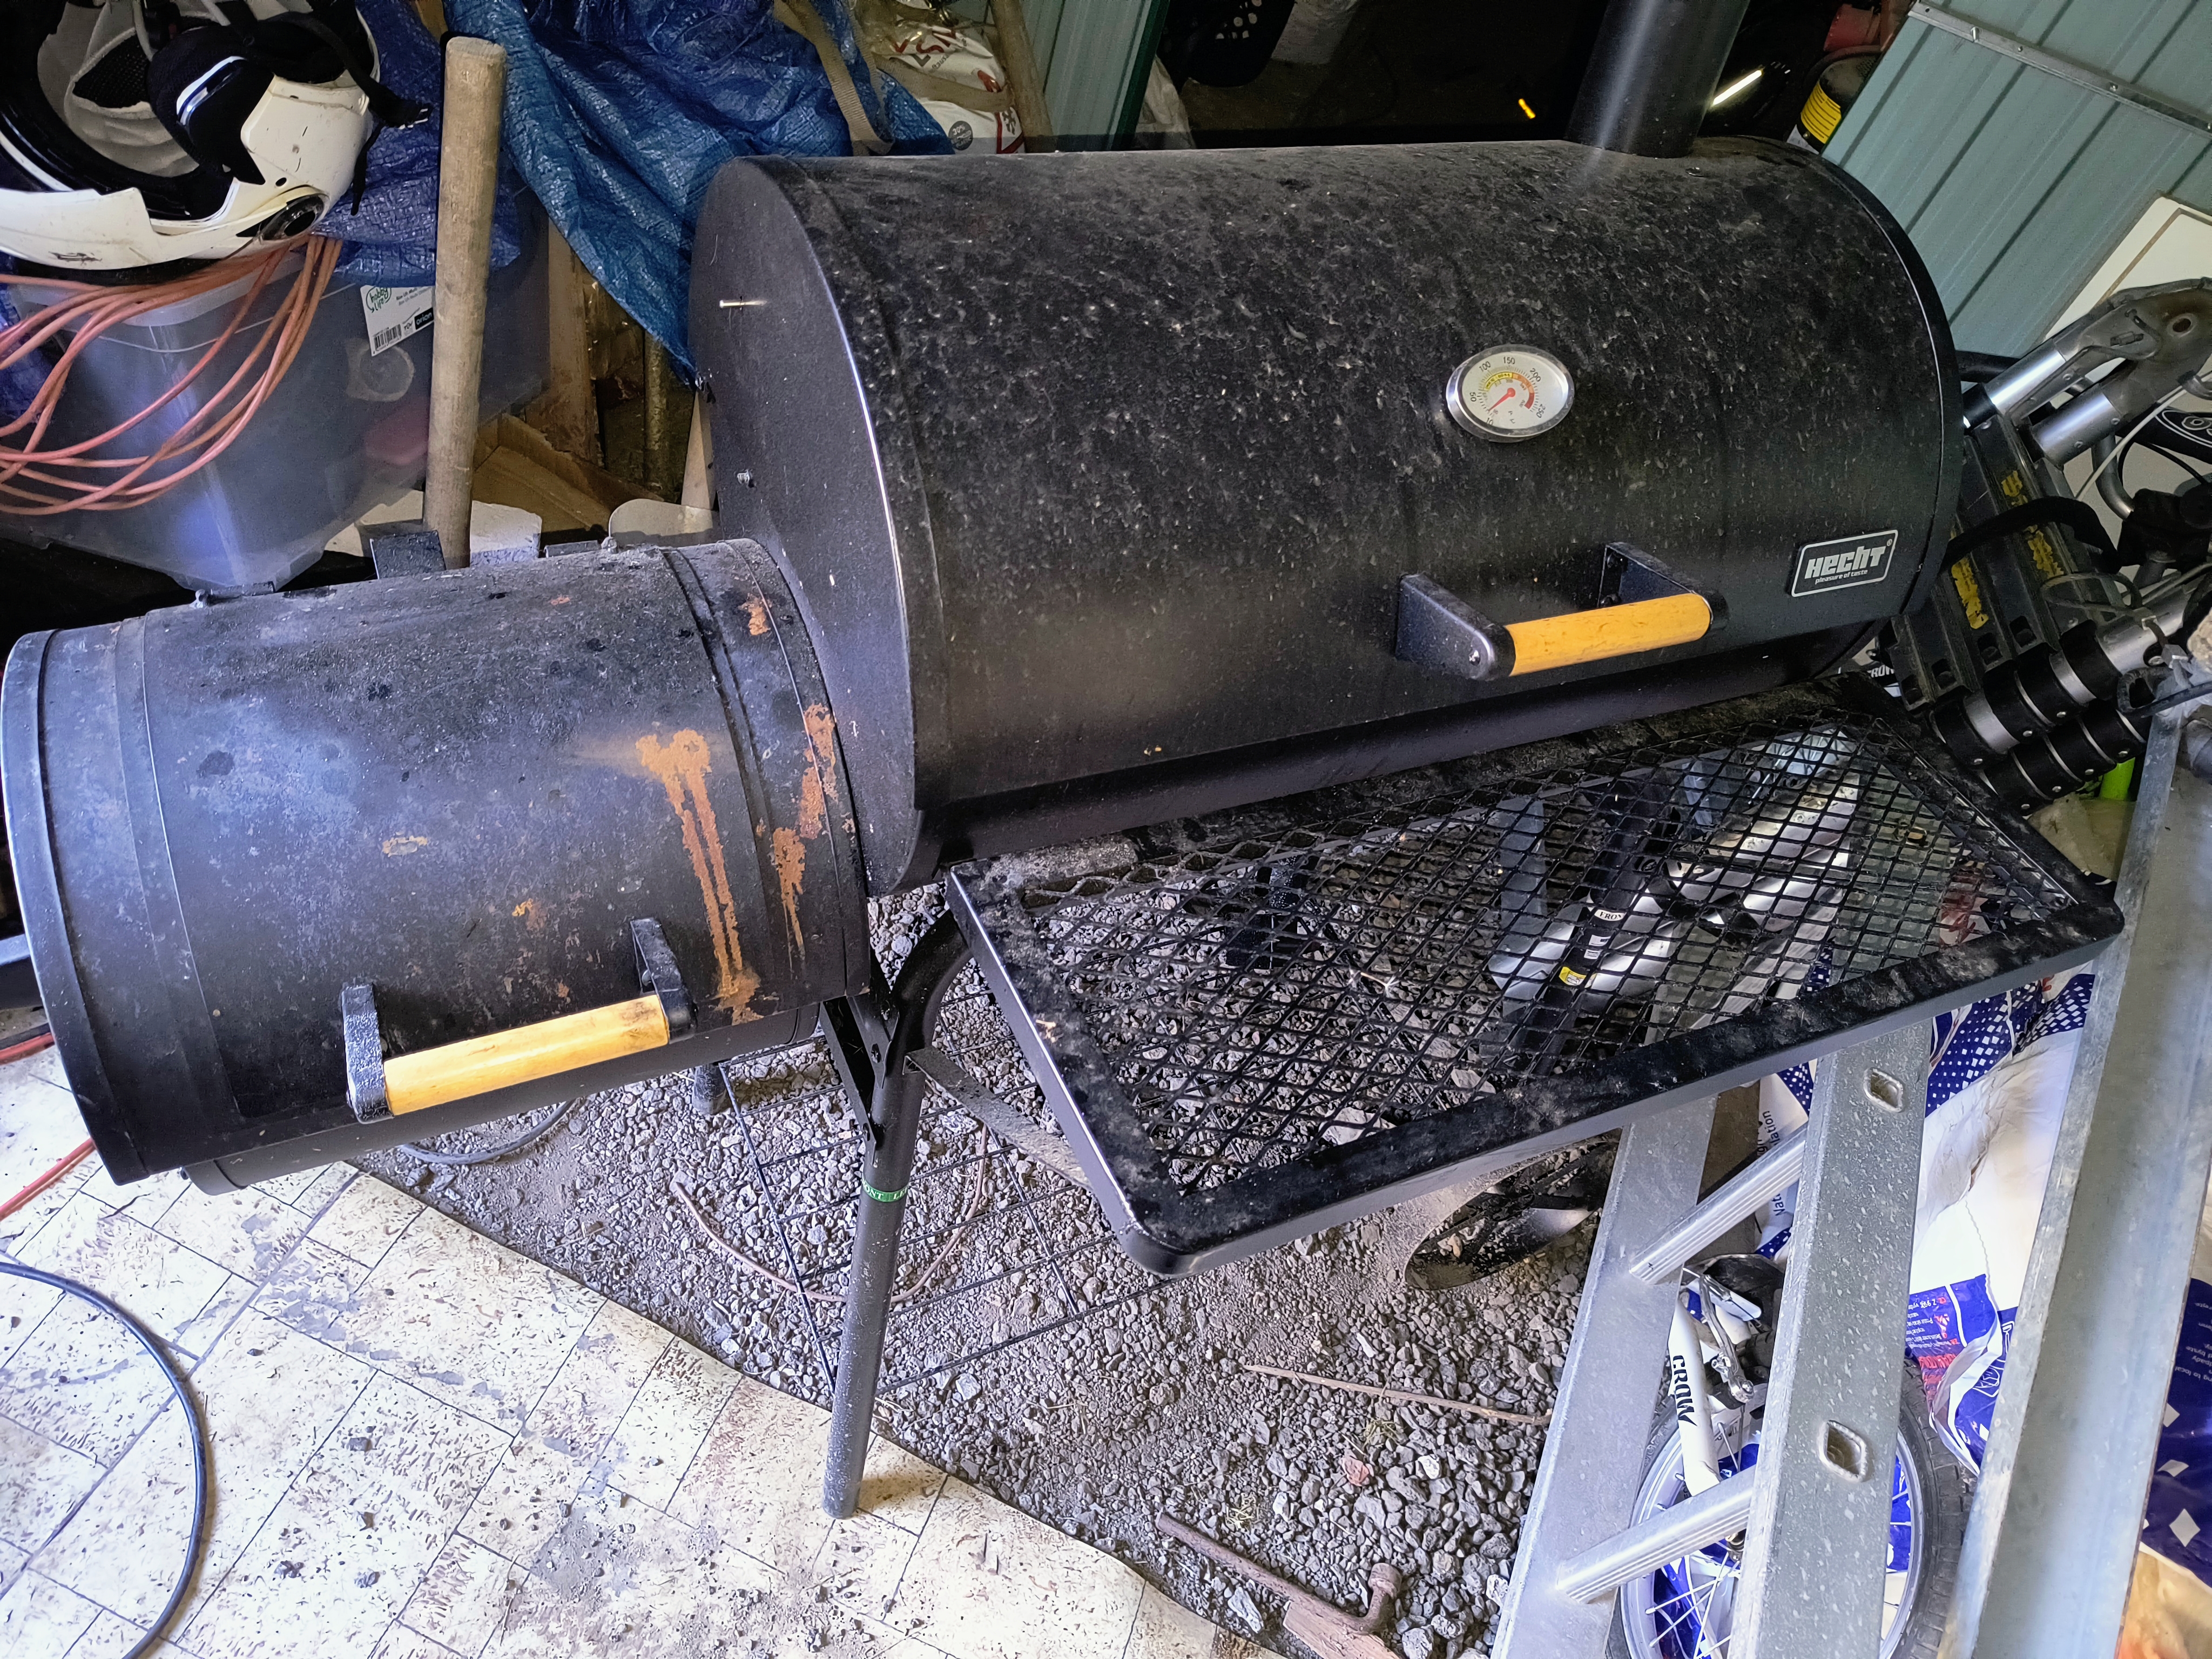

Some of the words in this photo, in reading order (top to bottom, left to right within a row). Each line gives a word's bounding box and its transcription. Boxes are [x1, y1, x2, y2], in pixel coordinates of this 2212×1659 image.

[1503, 356, 1515, 365] 150
[1479, 361, 1491, 372] 100
[1529, 368, 1541, 382] 200
[1469, 392, 1476, 402] 50
[1536, 403, 1546, 418] 250
[1815, 574, 1843, 585] pleasure
[1762, 1110, 1781, 1146] lation
